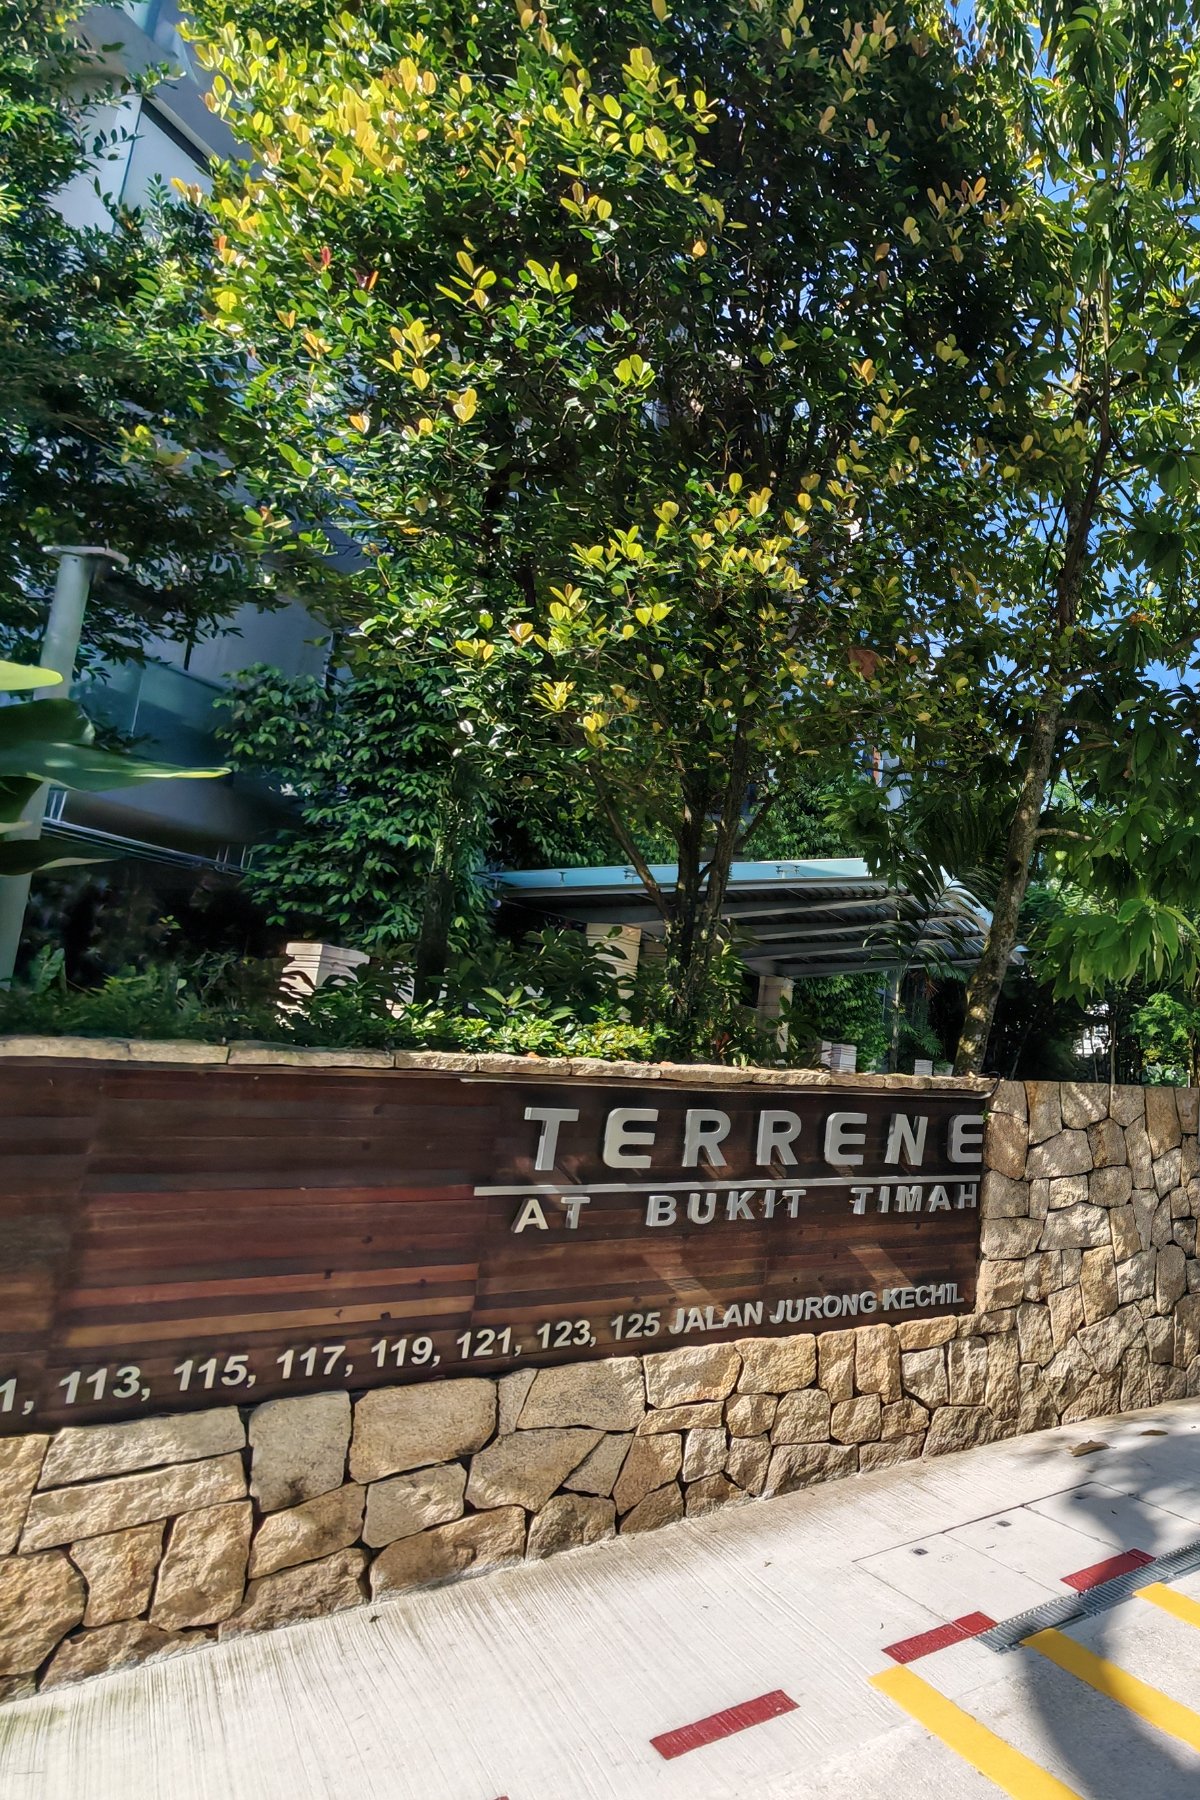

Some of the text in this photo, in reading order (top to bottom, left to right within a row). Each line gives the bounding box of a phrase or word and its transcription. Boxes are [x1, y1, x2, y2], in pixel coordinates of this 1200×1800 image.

[524, 1106, 985, 1171] TERRENE
[510, 1183, 978, 1234] AT BUKIT TIMAH
[58, 1365, 151, 1402] 113,
[173, 1354, 257, 1392] 115,
[276, 1345, 355, 1379] 117,
[370, 1336, 442, 1369] 119,
[455, 1326, 523, 1360] 121,
[536, 1319, 598, 1349] 123,
[610, 1311, 661, 1341] 125
[669, 1300, 764, 1335] JALAN
[769, 1290, 878, 1325] JURONG
[882, 1282, 965, 1312] KECHIL
